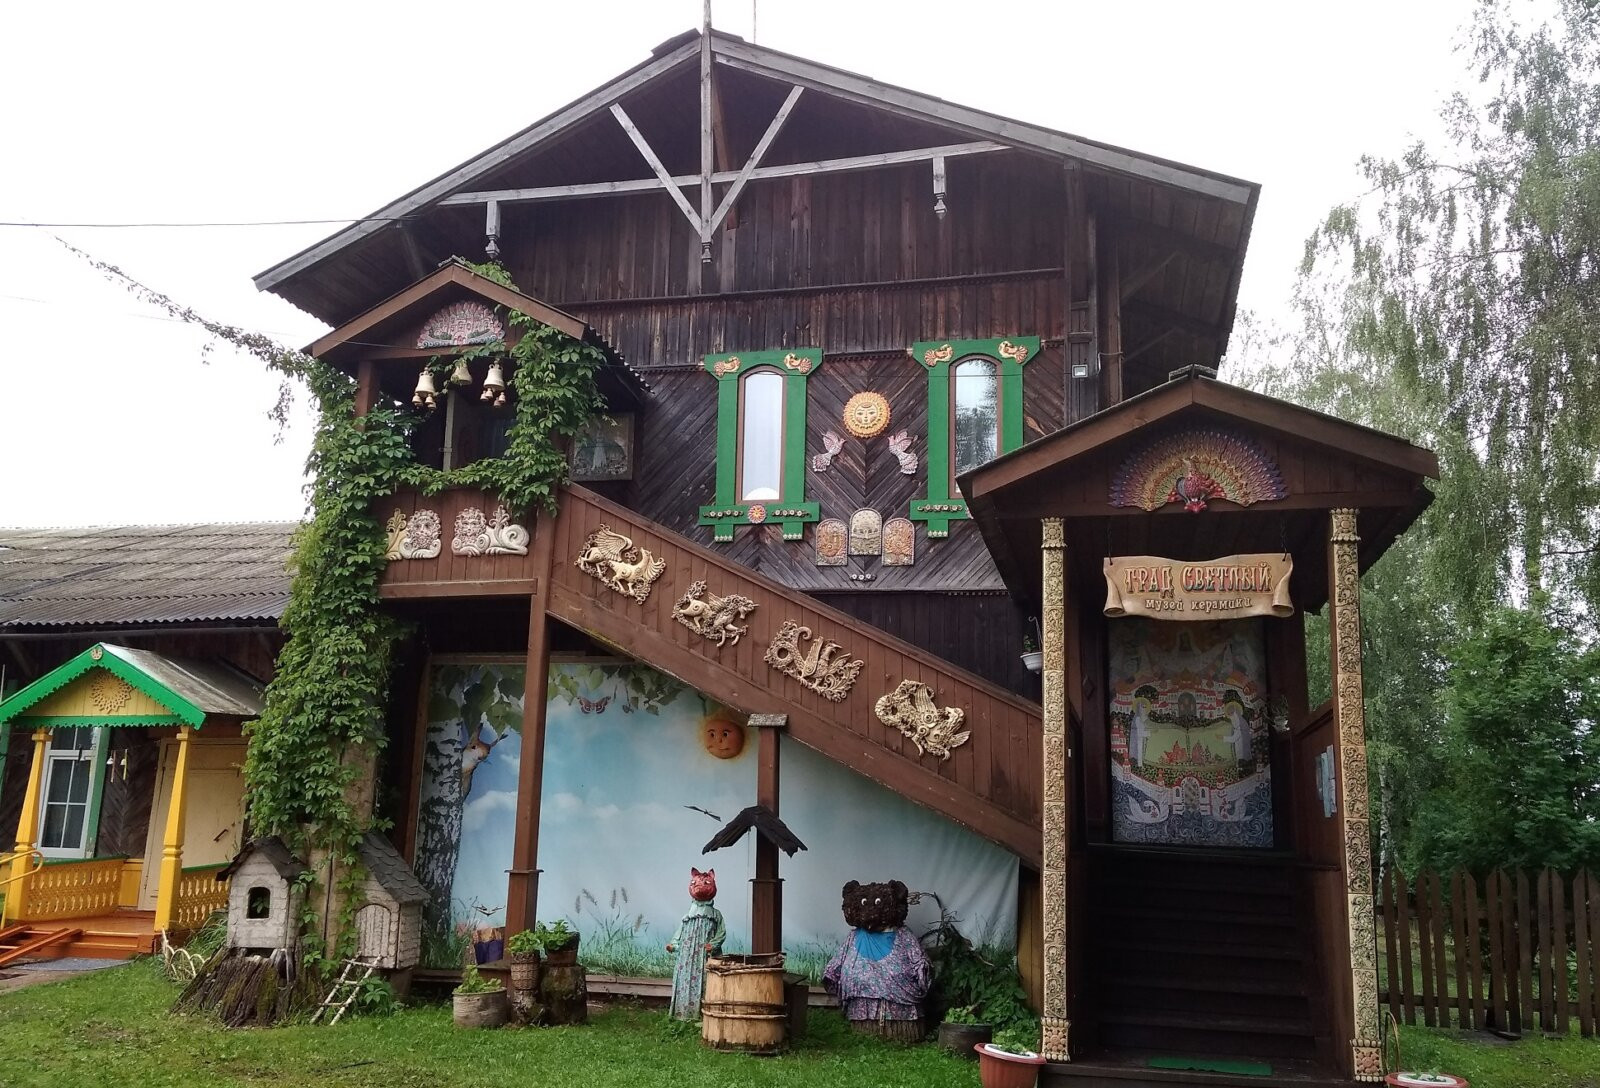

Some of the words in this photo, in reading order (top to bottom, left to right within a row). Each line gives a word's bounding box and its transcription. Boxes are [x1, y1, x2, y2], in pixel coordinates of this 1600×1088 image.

[1125, 565, 1174, 598] ГРАД
[1181, 562, 1272, 593] СВЕТЛЫЙ
[1191, 597, 1252, 613] керамики
